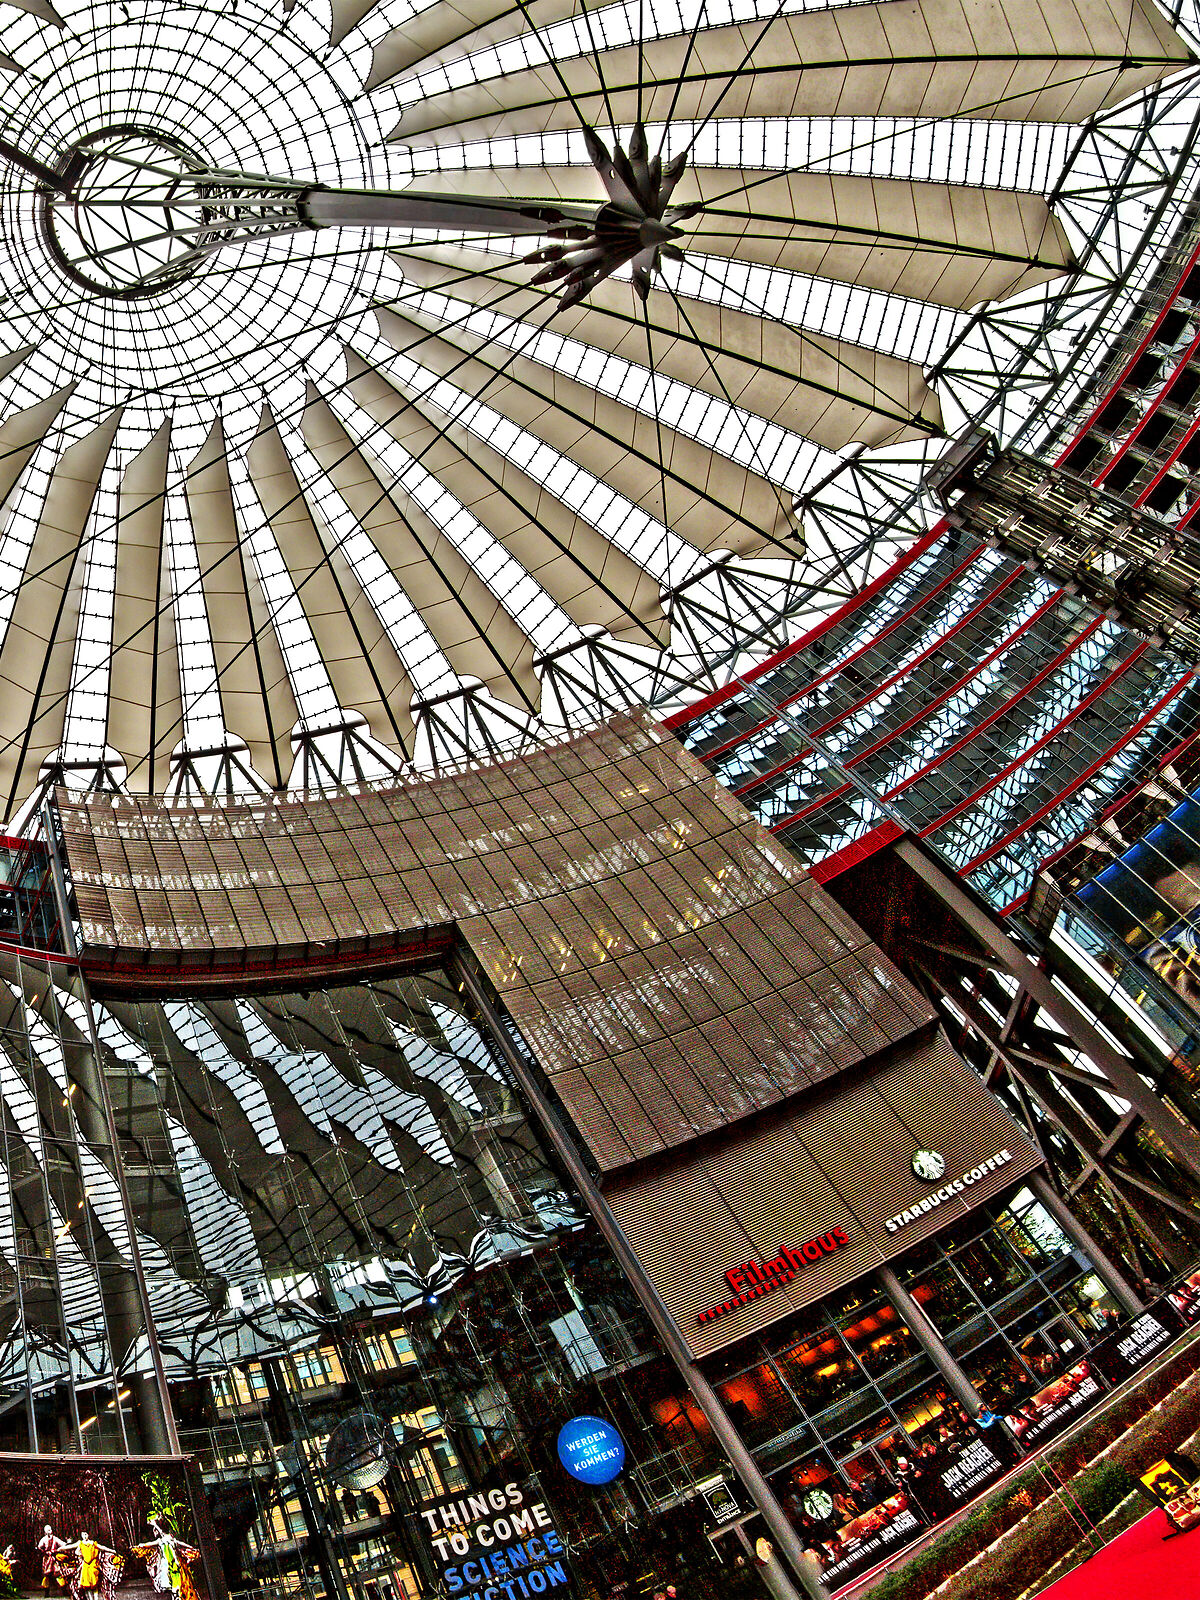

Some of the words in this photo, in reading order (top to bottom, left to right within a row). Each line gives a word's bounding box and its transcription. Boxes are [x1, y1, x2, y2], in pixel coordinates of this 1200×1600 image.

[885, 1179, 965, 1232] STARBUCKS
[962, 1148, 1013, 1185] COFFEE
[725, 1226, 850, 1293] Filmhaus
[1116, 1337, 1138, 1357] JACK
[1131, 1318, 1163, 1344] REACHER
[1068, 1392, 1086, 1406] JACK
[566, 1430, 607, 1452] WERDEN
[573, 1447, 620, 1472] KOMMEN?
[583, 1444, 599, 1457] SIE
[941, 1465, 965, 1489] JACK
[958, 1445, 994, 1478] REACHER
[420, 1482, 524, 1533] THINGS
[431, 1532, 470, 1562] TO
[476, 1503, 552, 1547] COME
[880, 1525, 900, 1542] JACK
[444, 1530, 564, 1592] SCIENCE
[457, 1561, 568, 1600] CTION
